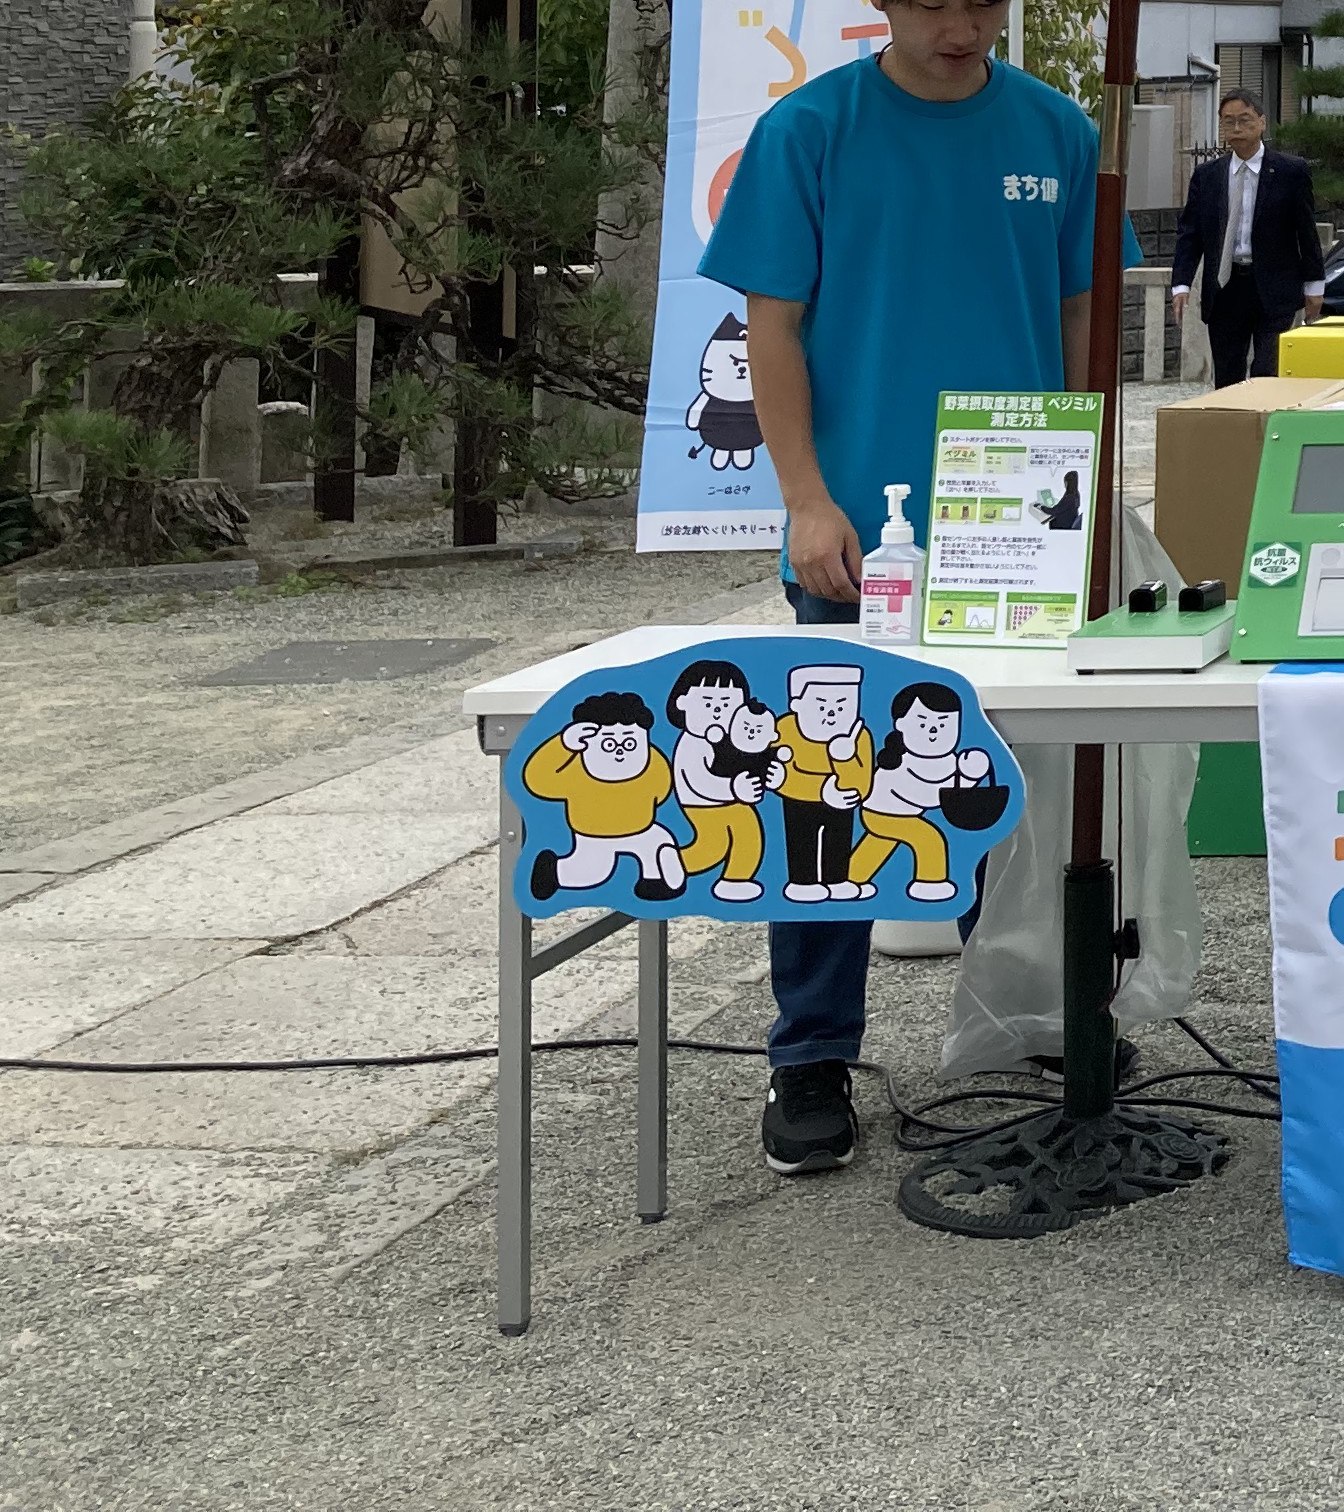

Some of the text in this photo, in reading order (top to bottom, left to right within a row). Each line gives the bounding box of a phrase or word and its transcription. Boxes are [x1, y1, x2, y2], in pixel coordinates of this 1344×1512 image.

[1003, 174, 1059, 203] まち健
[944, 395, 1097, 411] 野菜摂取度測定器 ベジミル
[990, 413, 1048, 428] 測定方法
[1253, 557, 1297, 566] 抗ウィルス
